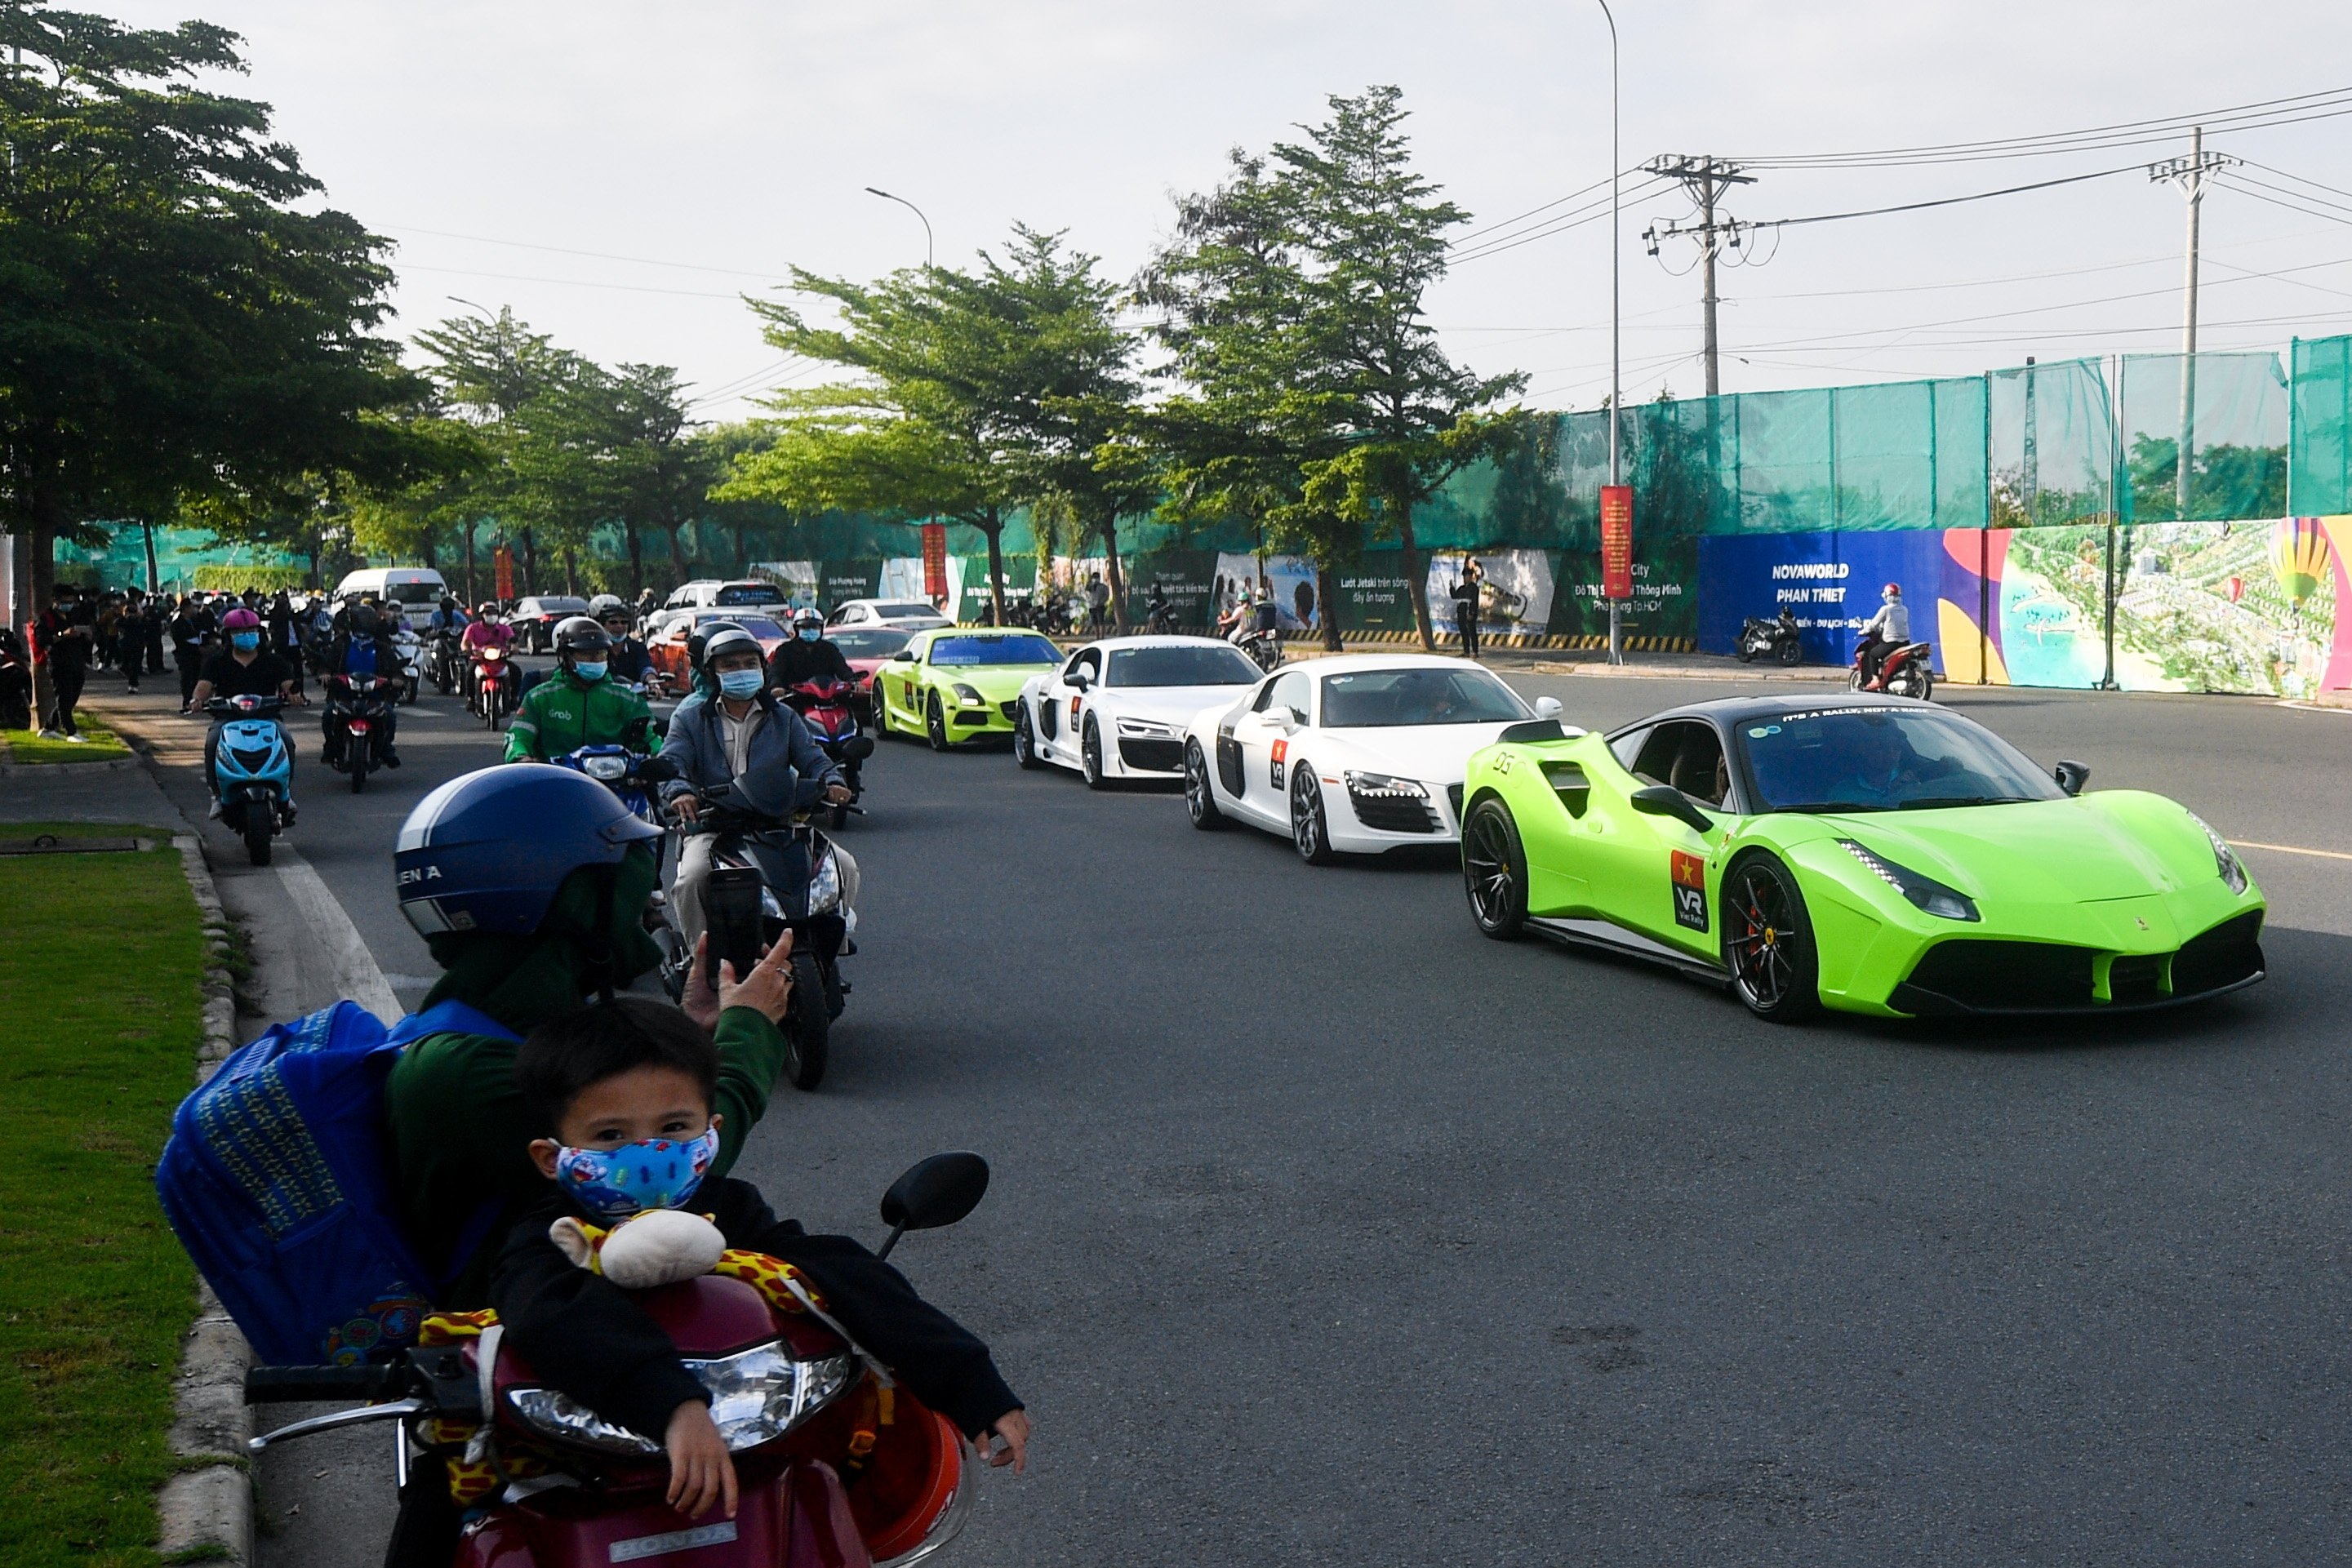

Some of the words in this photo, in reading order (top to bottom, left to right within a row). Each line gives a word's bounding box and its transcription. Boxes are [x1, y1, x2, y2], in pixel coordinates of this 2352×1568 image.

[1630, 564, 1650, 578] City
[1772, 563, 1849, 580] NOVAWORLD
[1662, 584, 1682, 595] Minh
[1776, 588, 1809, 603] PHAN
[1812, 587, 1846, 603] THIET
[549, 708, 571, 720] Grab
[1782, 713, 1807, 722] IT'S
[1272, 761, 1283, 780] VR
[1677, 886, 1702, 915] VR
[614, 1523, 735, 1558] HONDA
